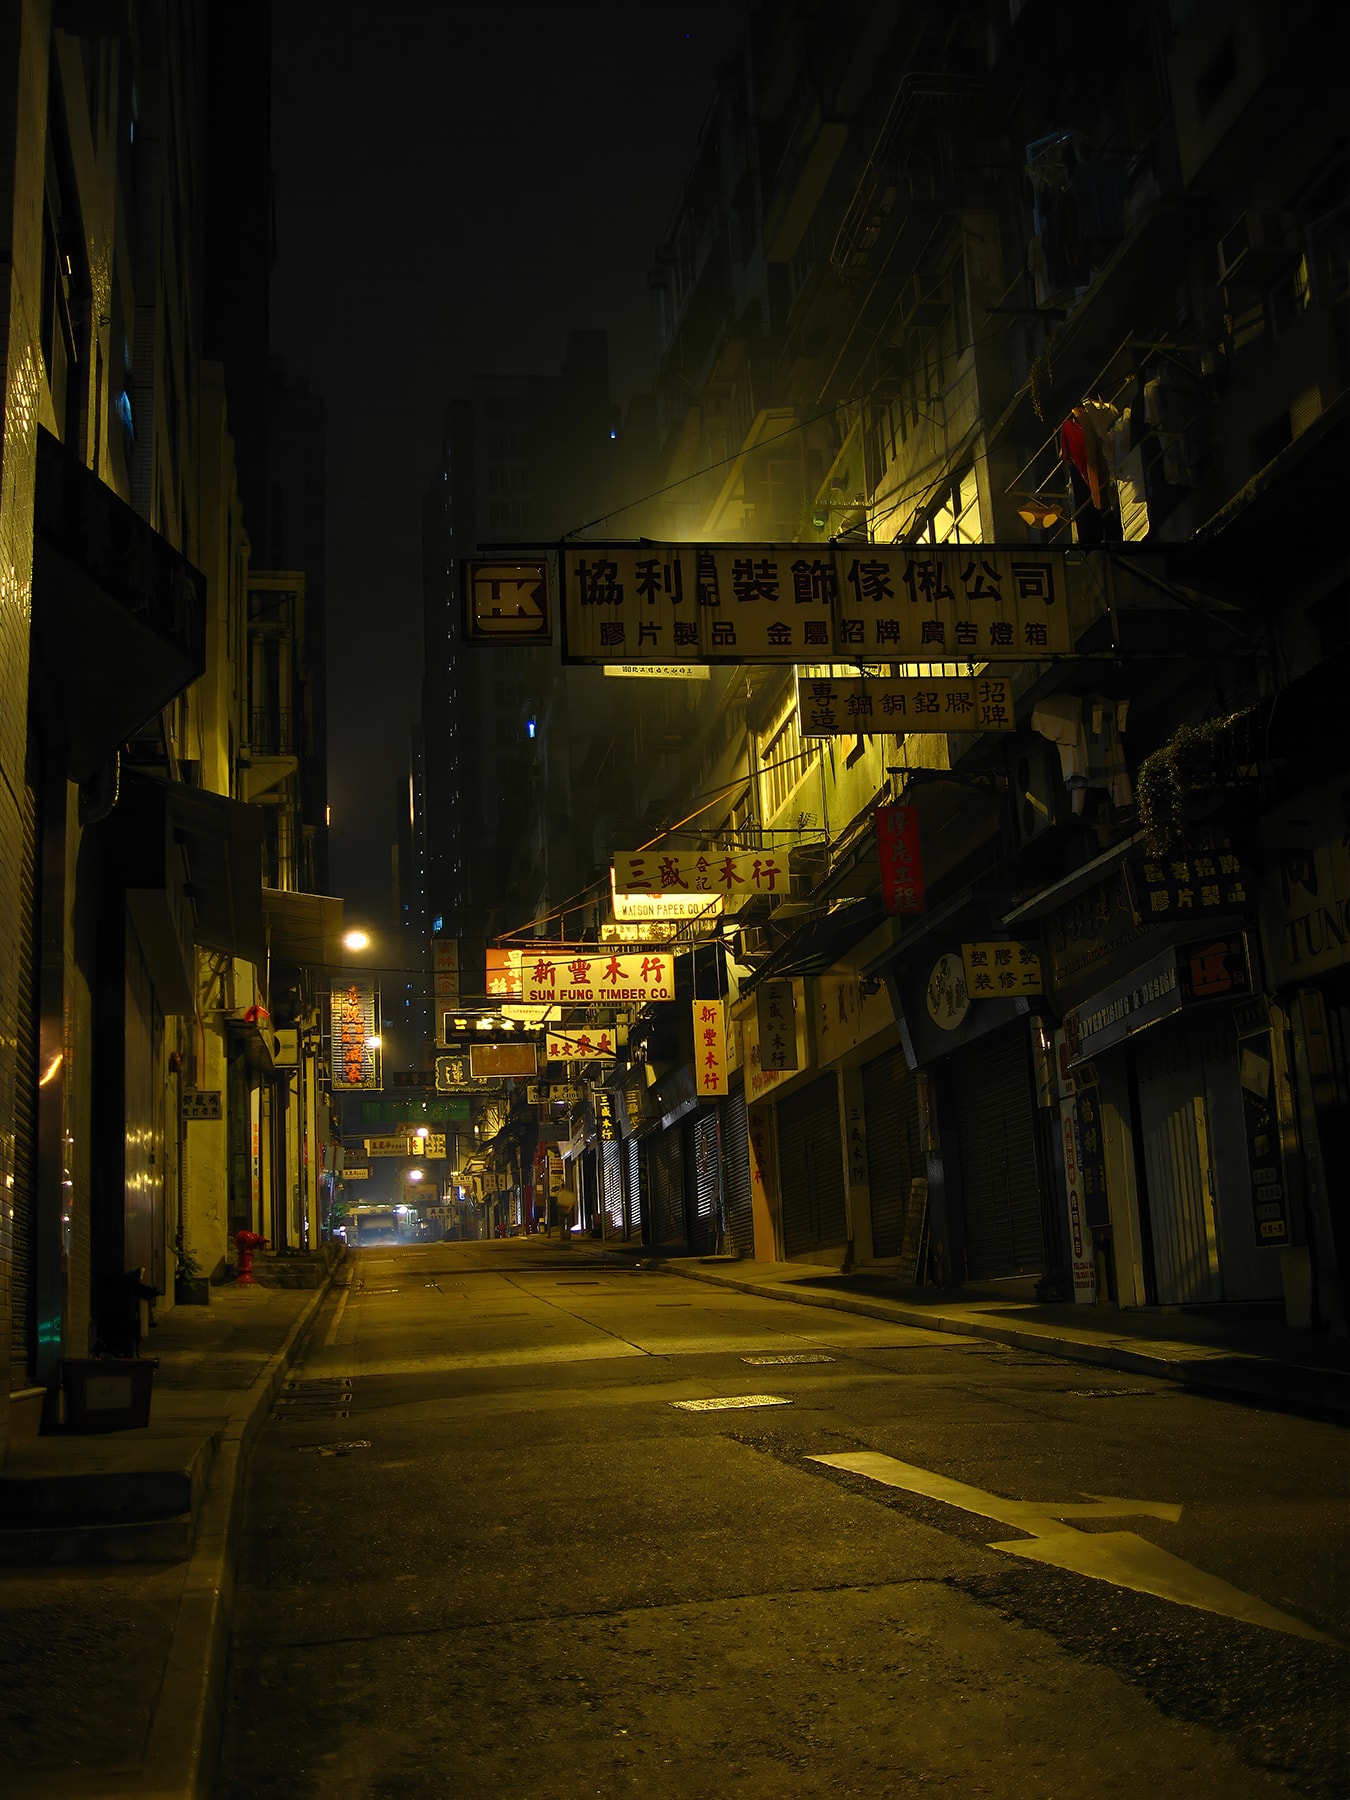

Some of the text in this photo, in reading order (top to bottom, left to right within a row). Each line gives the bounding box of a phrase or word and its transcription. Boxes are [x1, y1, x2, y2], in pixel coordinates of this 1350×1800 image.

[599, 620, 737, 647] 膠片製品
[921, 619, 1048, 647] 廣告燈箱
[621, 903, 654, 916] WATSON
[657, 904, 685, 915] PAPER
[1284, 893, 1350, 966] TUN
[531, 955, 666, 987] 新豐木行
[530, 987, 671, 1001] SUN FUNG TIMBER CO.
